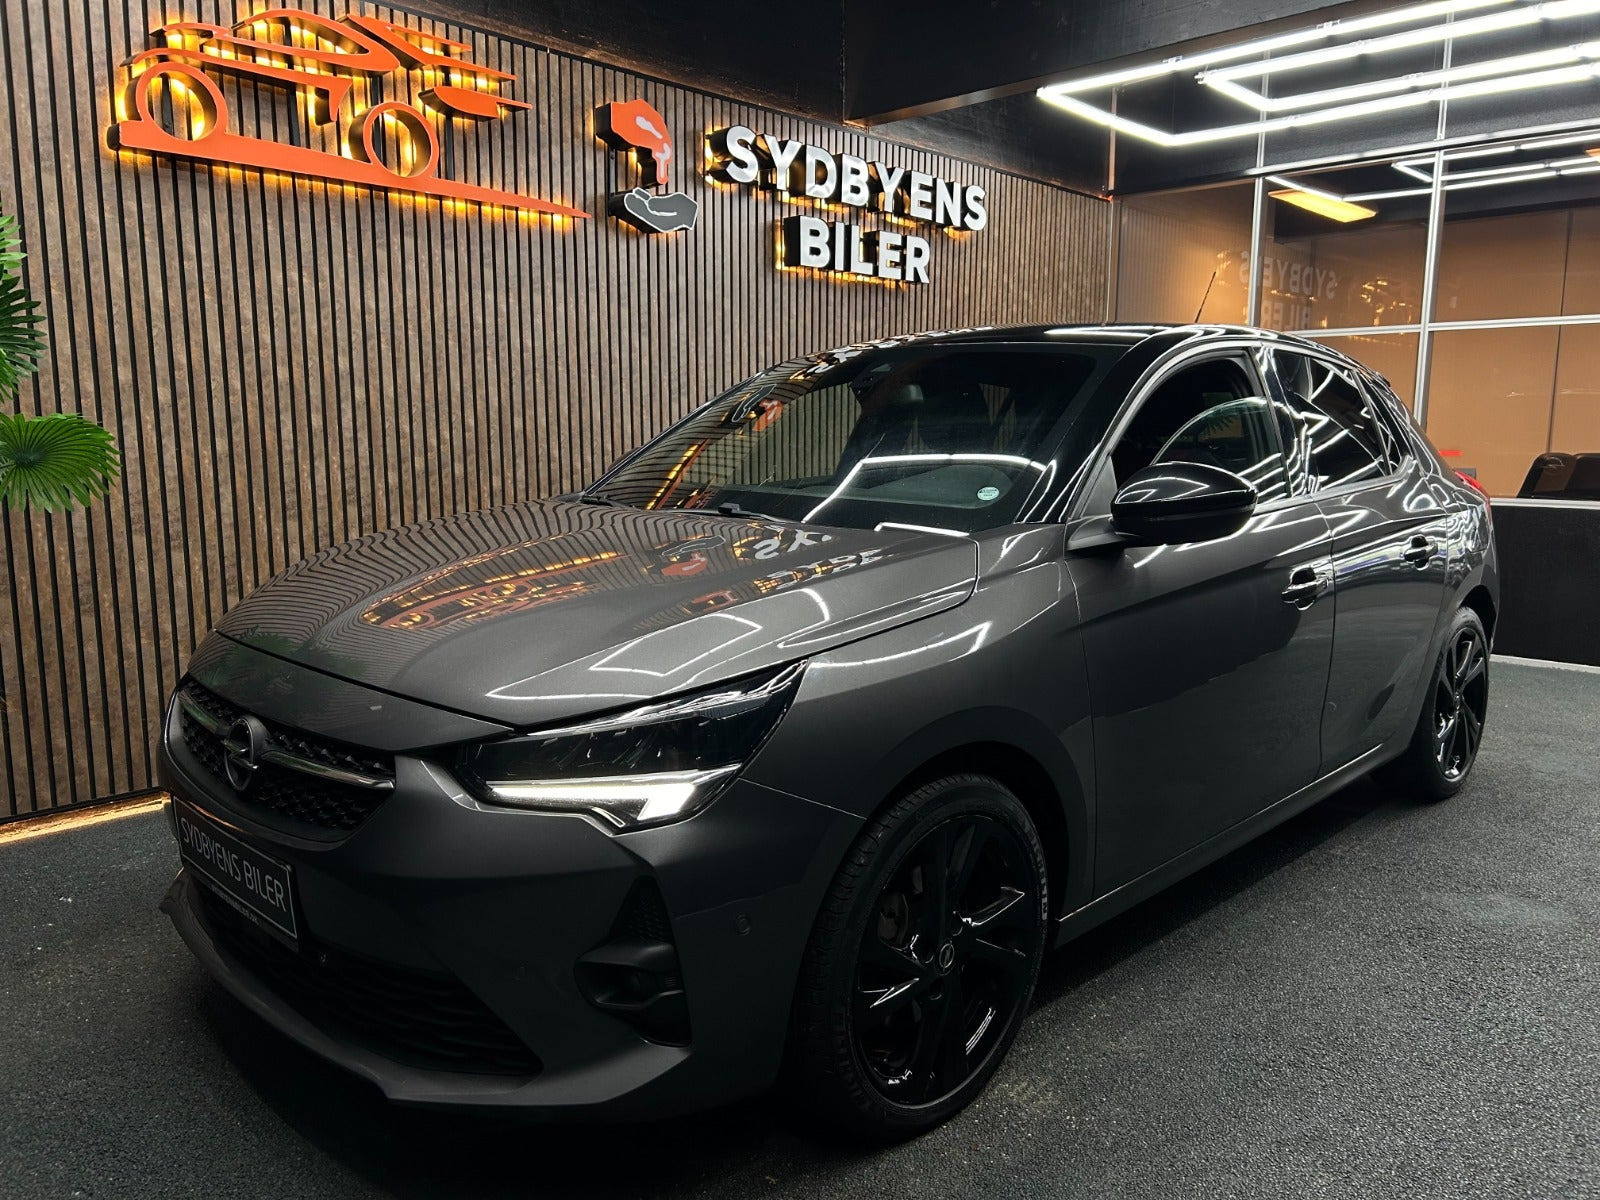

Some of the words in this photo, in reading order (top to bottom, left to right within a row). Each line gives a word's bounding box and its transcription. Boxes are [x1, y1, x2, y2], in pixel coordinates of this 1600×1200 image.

[726, 125, 987, 231] SYDBYENS
[800, 215, 930, 284] BILER
[180, 817, 241, 882] SYDBYENS
[243, 860, 287, 913] BILER
